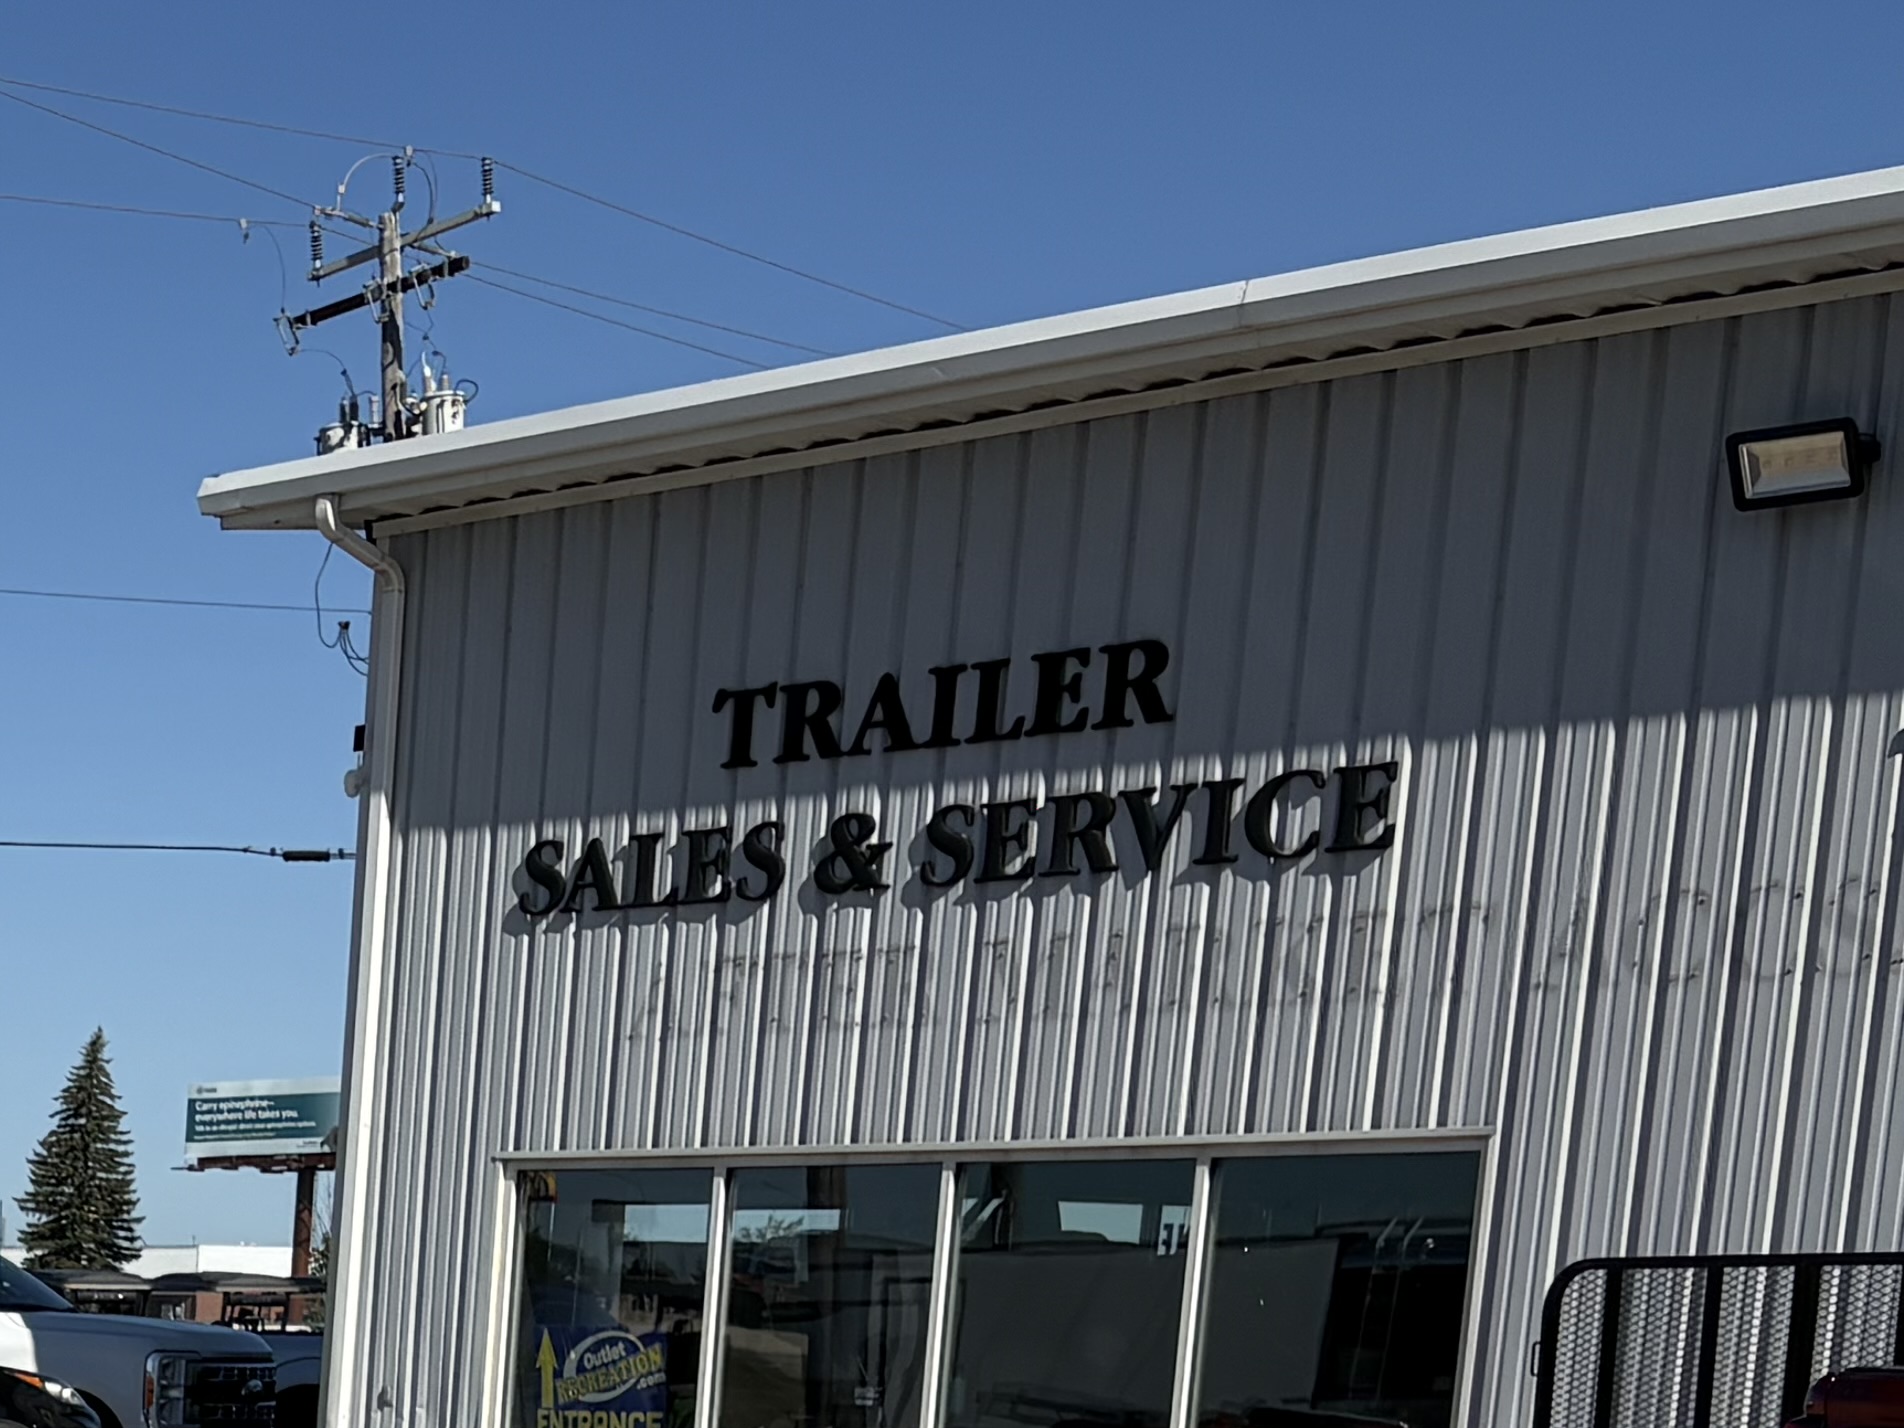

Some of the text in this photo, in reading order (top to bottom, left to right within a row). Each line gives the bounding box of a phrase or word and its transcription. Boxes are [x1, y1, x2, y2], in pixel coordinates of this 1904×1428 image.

[712, 638, 1174, 770] TRAILER
[517, 761, 1399, 918] SALES & SERVICE
[556, 1342, 664, 1406] RECREATION
[583, 1341, 626, 1370] Outlet
[636, 1371, 667, 1391] .com
